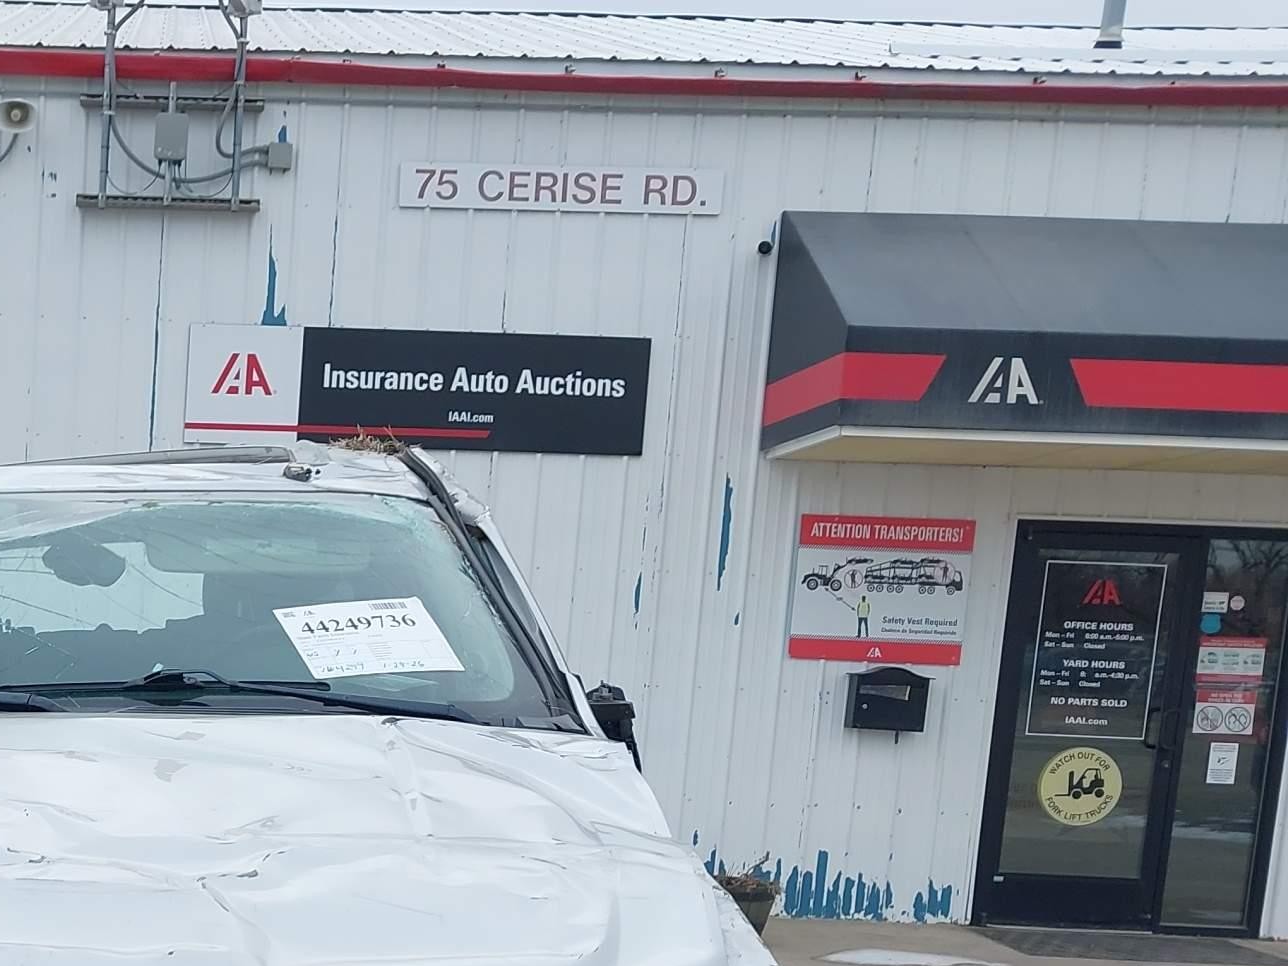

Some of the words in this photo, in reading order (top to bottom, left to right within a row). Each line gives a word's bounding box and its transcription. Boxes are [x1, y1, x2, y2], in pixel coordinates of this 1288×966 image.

[415, 168, 458, 200] 75
[478, 170, 624, 205] CERISE
[643, 174, 707, 207] RD.
[323, 363, 444, 392] Insurance
[451, 366, 510, 393] Auto
[515, 369, 627, 398] Auctions
[448, 411, 495, 425] IAAI.com
[810, 522, 871, 540] ATTENTION
[874, 525, 964, 543] TRANSPORTERS!
[301, 613, 417, 635] 44249736
[882, 615, 906, 626] Safety
[907, 617, 923, 626] Vest
[924, 617, 958, 628] Required
[1063, 620, 1098, 630] OFFICE
[1099, 622, 1134, 631] HOURS
[1045, 631, 1060, 639] Mon
[1063, 659, 1089, 668] YARD
[1090, 660, 1126, 669] HOURS
[1050, 696, 1066, 705] NO
[1067, 697, 1099, 706] PARTS
[1100, 699, 1128, 708] SOLD
[1048, 752, 1076, 775] WATCH
[1077, 751, 1096, 760] OUT
[1094, 756, 1111, 771] FOR
[1045, 796, 1063, 816] FORK
[1063, 812, 1082, 821] LIFT
[1085, 794, 1114, 819] TRUCKS
